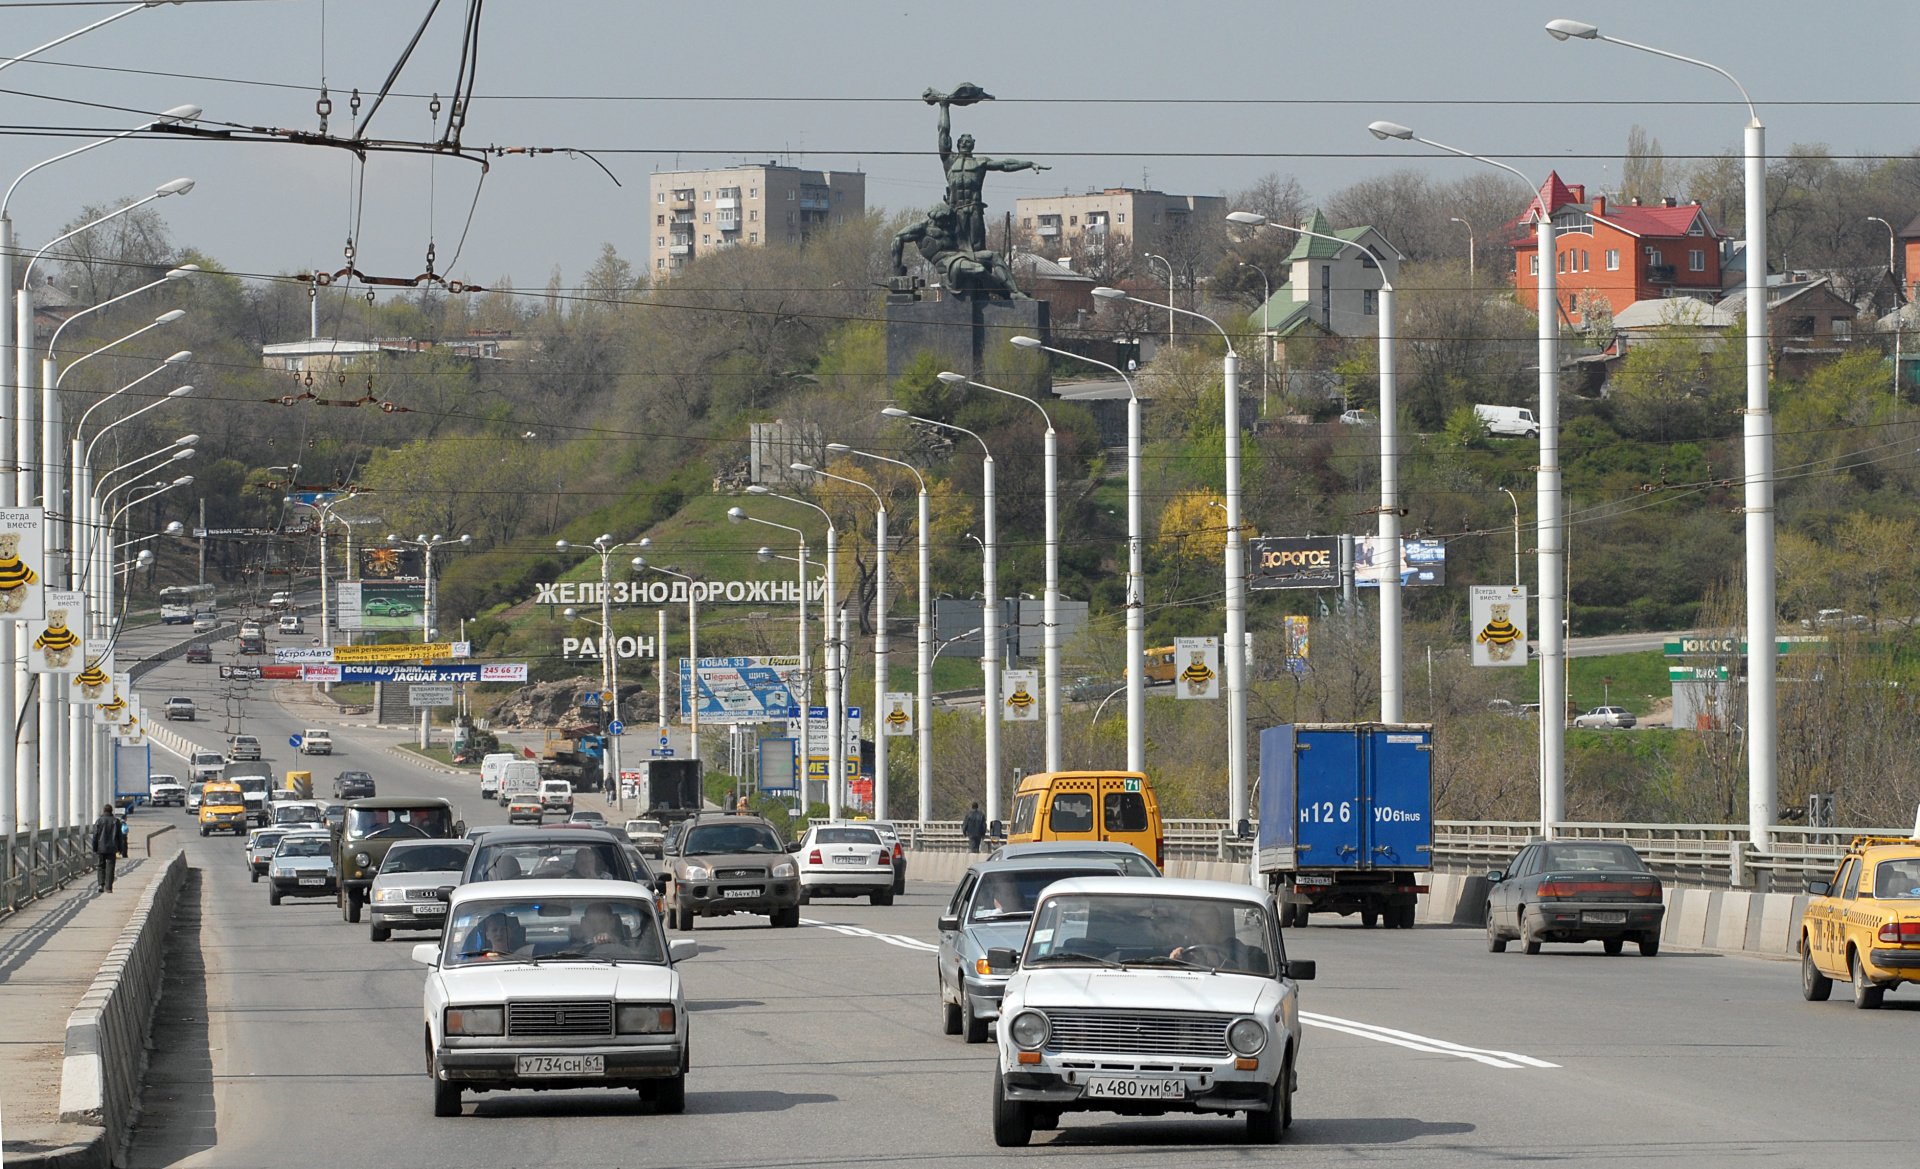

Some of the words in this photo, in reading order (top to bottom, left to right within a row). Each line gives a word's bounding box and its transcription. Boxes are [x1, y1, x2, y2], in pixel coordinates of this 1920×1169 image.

[0, 511, 30, 520] Всегда
[7, 521, 37, 529] вместе
[1260, 550, 1331, 569] ДОРОГОЕ
[535, 576, 828, 604] ЖЕЛЕЗНОДОРОЖНЫЙ
[360, 644, 410, 653] региональный
[563, 635, 655, 659] РАОН
[1682, 639, 1732, 652] ЮКОС
[278, 649, 332, 658] Астро-Авто
[734, 658, 745, 667] 33
[305, 666, 322, 675] World
[345, 665, 373, 674] всем
[484, 666, 499, 674] 245
[501, 666, 511, 674] 66
[513, 666, 524, 674] 77
[393, 672, 437, 682] JAGUAR
[438, 672, 477, 682] X-TYPE
[711, 672, 739, 682] legrand
[1126, 779, 1139, 790] 71
